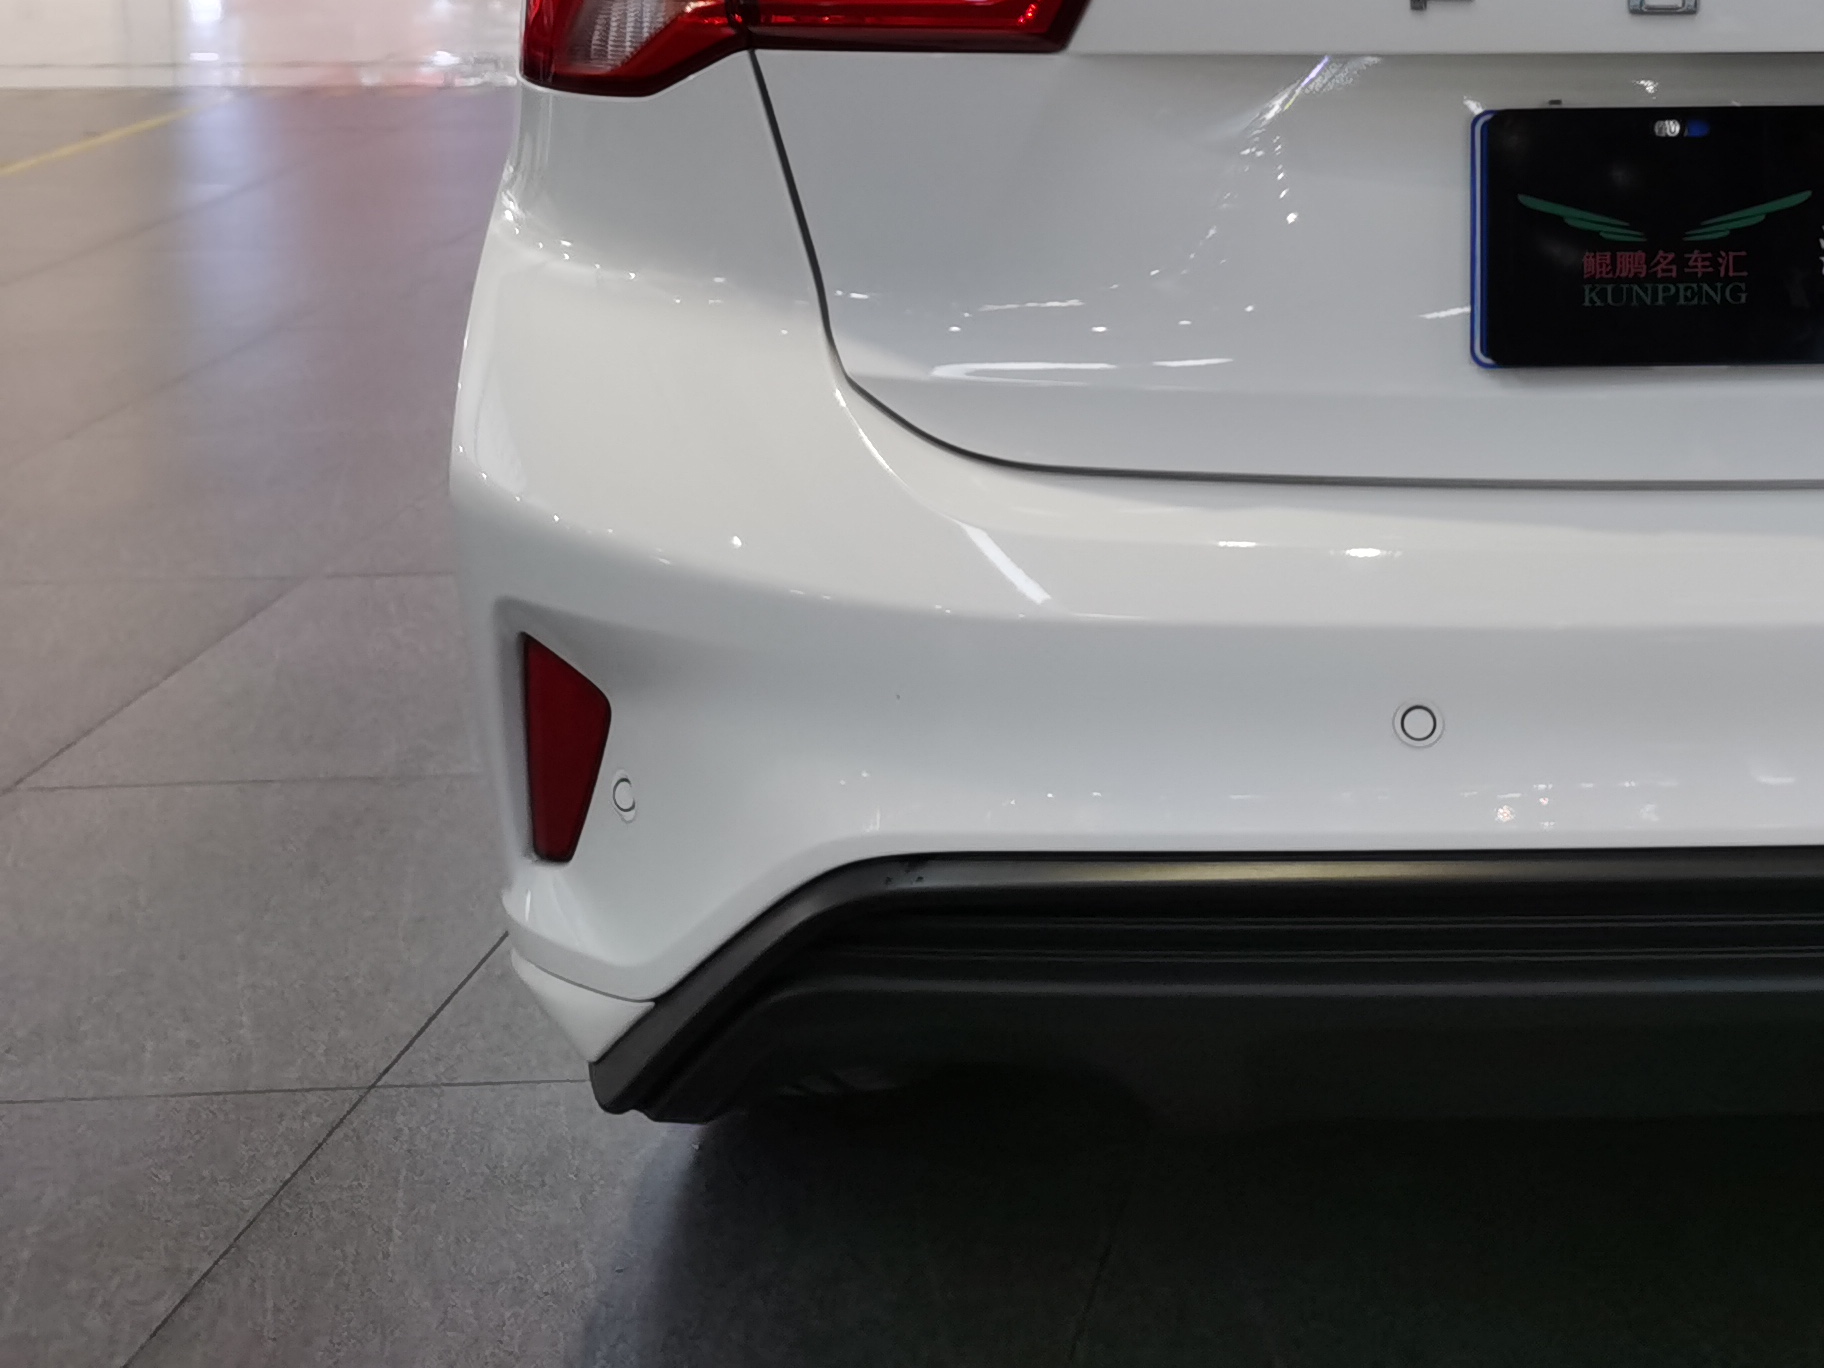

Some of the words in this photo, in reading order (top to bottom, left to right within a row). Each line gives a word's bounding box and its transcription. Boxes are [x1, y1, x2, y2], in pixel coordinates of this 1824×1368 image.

[1582, 249, 1749, 280] 鲲鹏名车汇
[1582, 283, 1748, 307] KUNPENG
